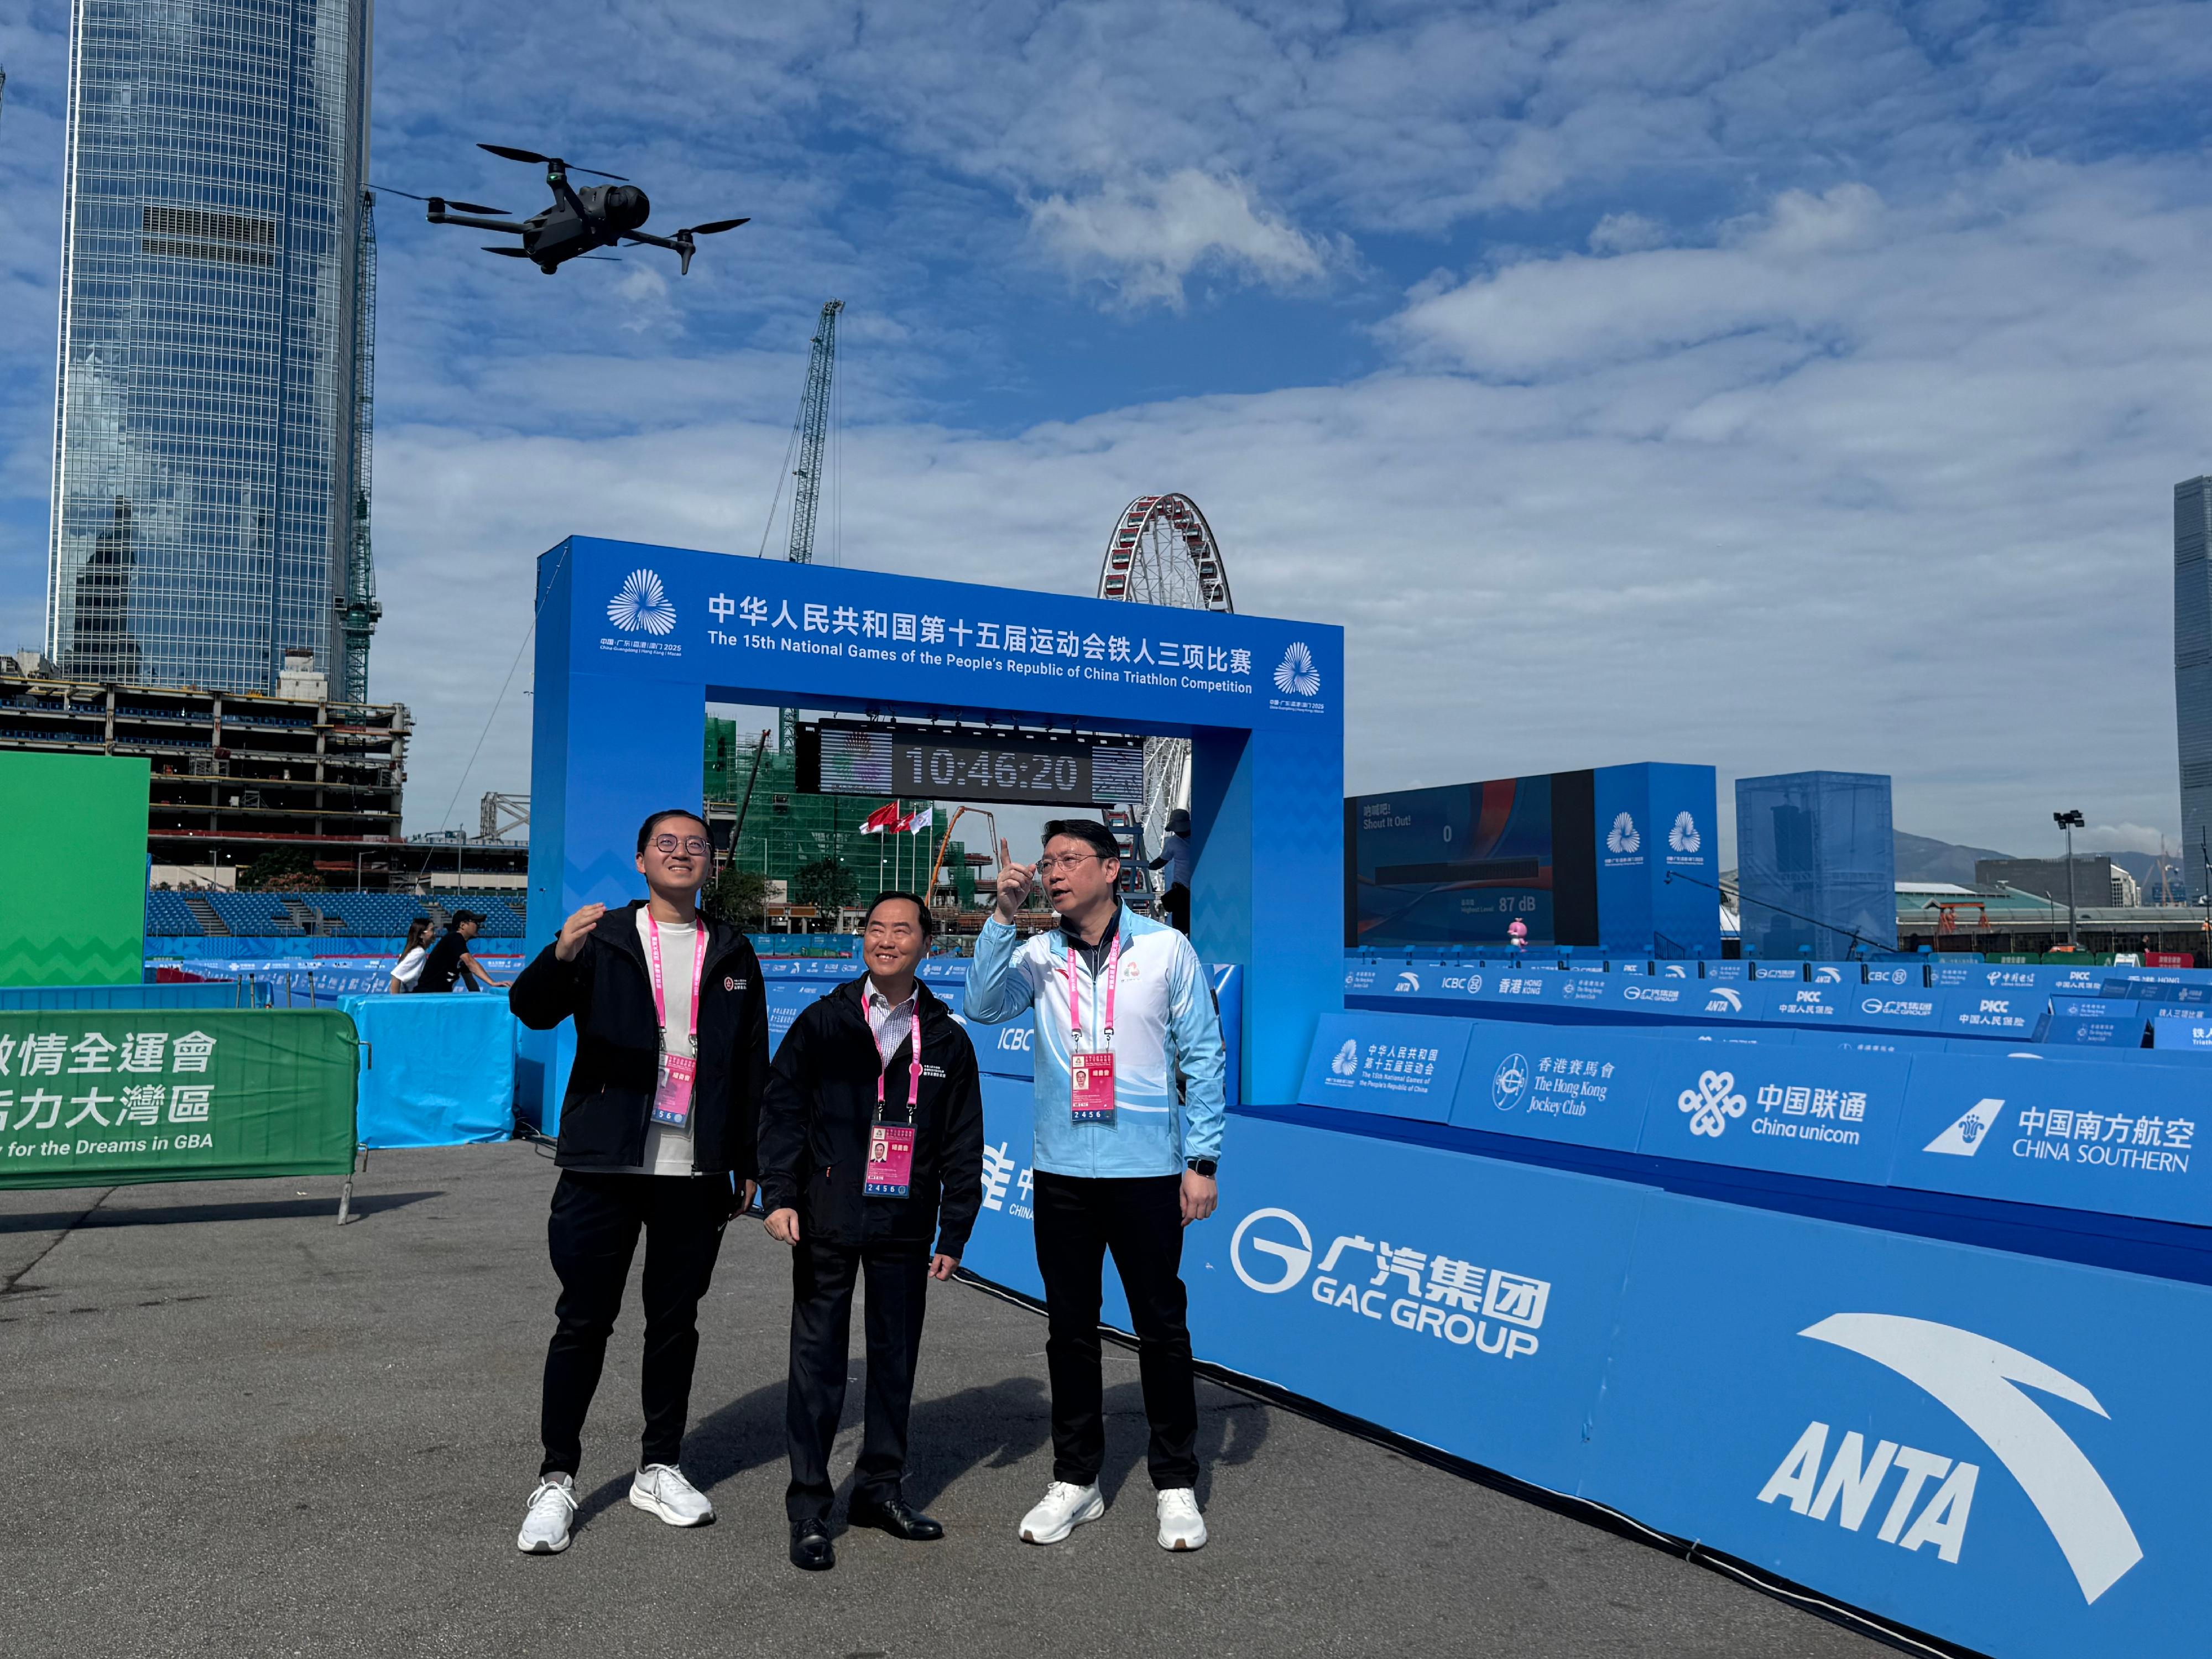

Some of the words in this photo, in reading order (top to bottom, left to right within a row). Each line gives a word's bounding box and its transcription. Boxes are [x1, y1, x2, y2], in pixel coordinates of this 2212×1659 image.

[708, 592, 1251, 675] 中华人民共和国第十五届运动会铁人三项比赛
[707, 630, 737, 646] The
[743, 634, 775, 650] 15th
[781, 638, 842, 656] National
[848, 644, 896, 661] Games
[901, 650, 916, 662] of
[920, 651, 942, 665] the
[947, 654, 1002, 671] People's
[1007, 660, 1063, 676] Republic
[1067, 665, 1080, 678] of
[1084, 667, 1119, 682] China
[1124, 671, 1177, 687] Triathlon
[1181, 676, 1252, 694] Competition
[906, 747, 1077, 791] 10:46:20
[1363, 818, 1385, 830] Shout
[1387, 817, 1393, 827] It
[1395, 815, 1411, 826] Out!
[1499, 897, 1515, 912] 87
[1519, 895, 1536, 911] dB
[1442, 978, 1466, 989] ICBC
[1499, 978, 1522, 994] 香港
[1867, 972, 1890, 982] CBC
[2070, 972, 2090, 980] PICC
[1704, 1000, 1728, 1012] ANTA
[1796, 991, 1822, 1003] PICC
[1980, 1000, 2009, 1013] PICC
[998, 1027, 1034, 1051] ICBC
[1368, 1044, 1438, 1061] 中华人民共和国
[1364, 1057, 1434, 1075] 第十五届运动会
[1538, 1057, 1615, 1078] 香港賽馬會
[1384, 1073, 1405, 1082] National
[1534, 1076, 1552, 1091] The
[1553, 1078, 1579, 1098] Hong
[1580, 1081, 1607, 1102] Kong
[1526, 1096, 1562, 1117] Jockey
[1562, 1099, 1587, 1117] Club
[1757, 1084, 1867, 1122] 中国联通
[1751, 1117, 1796, 1138] China
[1799, 1124, 1860, 1145] unicom
[2019, 1107, 2194, 1149] 中国南方航空
[8, 1141, 36, 1157] for
[41, 1140, 71, 1155] the
[76, 1136, 147, 1155] Dreams
[152, 1136, 168, 1150] in
[174, 1134, 213, 1150] GBA
[2012, 1139, 2070, 1161] CHINA
[2077, 1145, 2189, 1173] SOUTHERN
[1318, 1234, 1551, 1329] 广汽集团
[1312, 1276, 1386, 1320] GAC
[1390, 1298, 1539, 1359] GROUP
[1756, 1421, 1980, 1564] ANTA
